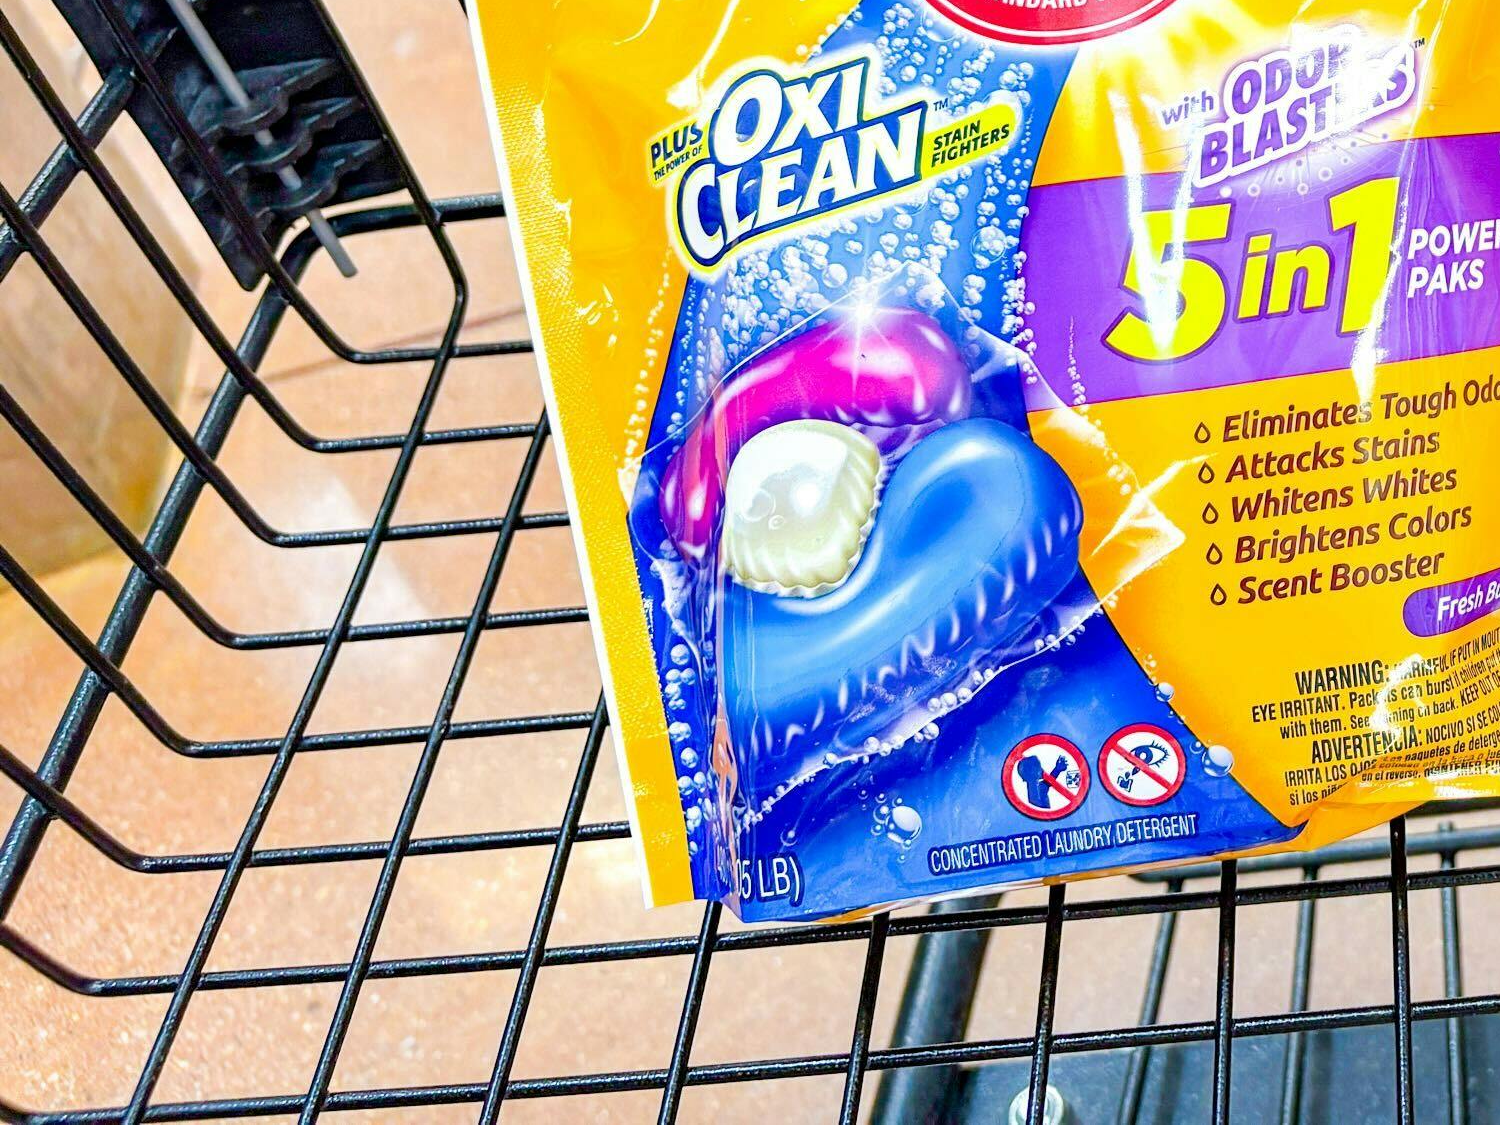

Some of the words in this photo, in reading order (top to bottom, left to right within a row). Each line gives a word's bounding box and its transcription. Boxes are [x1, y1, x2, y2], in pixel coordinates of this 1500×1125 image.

[713, 61, 868, 167] OXI
[932, 118, 982, 152] STAIN
[1161, 89, 1215, 126] with
[1199, 55, 1408, 180] BLASTS
[650, 121, 704, 168] PLUS
[653, 166, 666, 181] THE
[665, 151, 691, 174] POWER
[691, 144, 703, 157] OF
[930, 123, 1011, 169] FIGHTERS
[681, 106, 923, 262] CLEAN
[1406, 257, 1485, 299] PAKS
[1222, 397, 1374, 444] Eliminates
[1380, 379, 1458, 421] Tough
[1224, 440, 1346, 484] Attacks
[1352, 427, 1441, 465] Stains
[1231, 482, 1354, 524] Whitens
[1362, 464, 1458, 505] Whites
[1234, 520, 1381, 566] Brightens
[1388, 502, 1473, 541] Colors
[1237, 567, 1323, 606] Scent
[1329, 548, 1446, 588] Booster
[1436, 584, 1484, 622] Fresh
[1251, 702, 1277, 723] EYE
[1279, 693, 1346, 720] IRRITANT.
[1349, 687, 1398, 710] Packts
[1401, 684, 1423, 701] can
[1426, 675, 1455, 696] burst
[1459, 657, 1487, 685] children
[1294, 659, 1390, 696] WARNING:
[1456, 645, 1472, 665] PUT
[1472, 641, 1480, 655] IN
[1279, 719, 1308, 740] with
[1309, 716, 1347, 735] them.
[1350, 714, 1371, 730] See
[1417, 705, 1431, 718] on
[1432, 697, 1460, 719] back.
[1459, 681, 1480, 707] KEEP
[1479, 674, 1493, 697] OUT
[1284, 767, 1323, 788] IRRITA
[1325, 765, 1348, 784] LOS
[1453, 739, 1466, 754] de
[1311, 724, 1424, 764] ADVERTENCIA:
[1425, 720, 1465, 744] NOCIVO
[1465, 717, 1476, 735] SI
[1475, 709, 1488, 730] SE
[1289, 789, 1300, 807] si
[1302, 786, 1319, 805] los
[1375, 771, 1384, 782] el
[931, 833, 1042, 873] CONCENTRATED
[1046, 825, 1111, 857] LAUNDRY
[1116, 814, 1197, 844] DETERGENT
[757, 855, 800, 903] LB)
